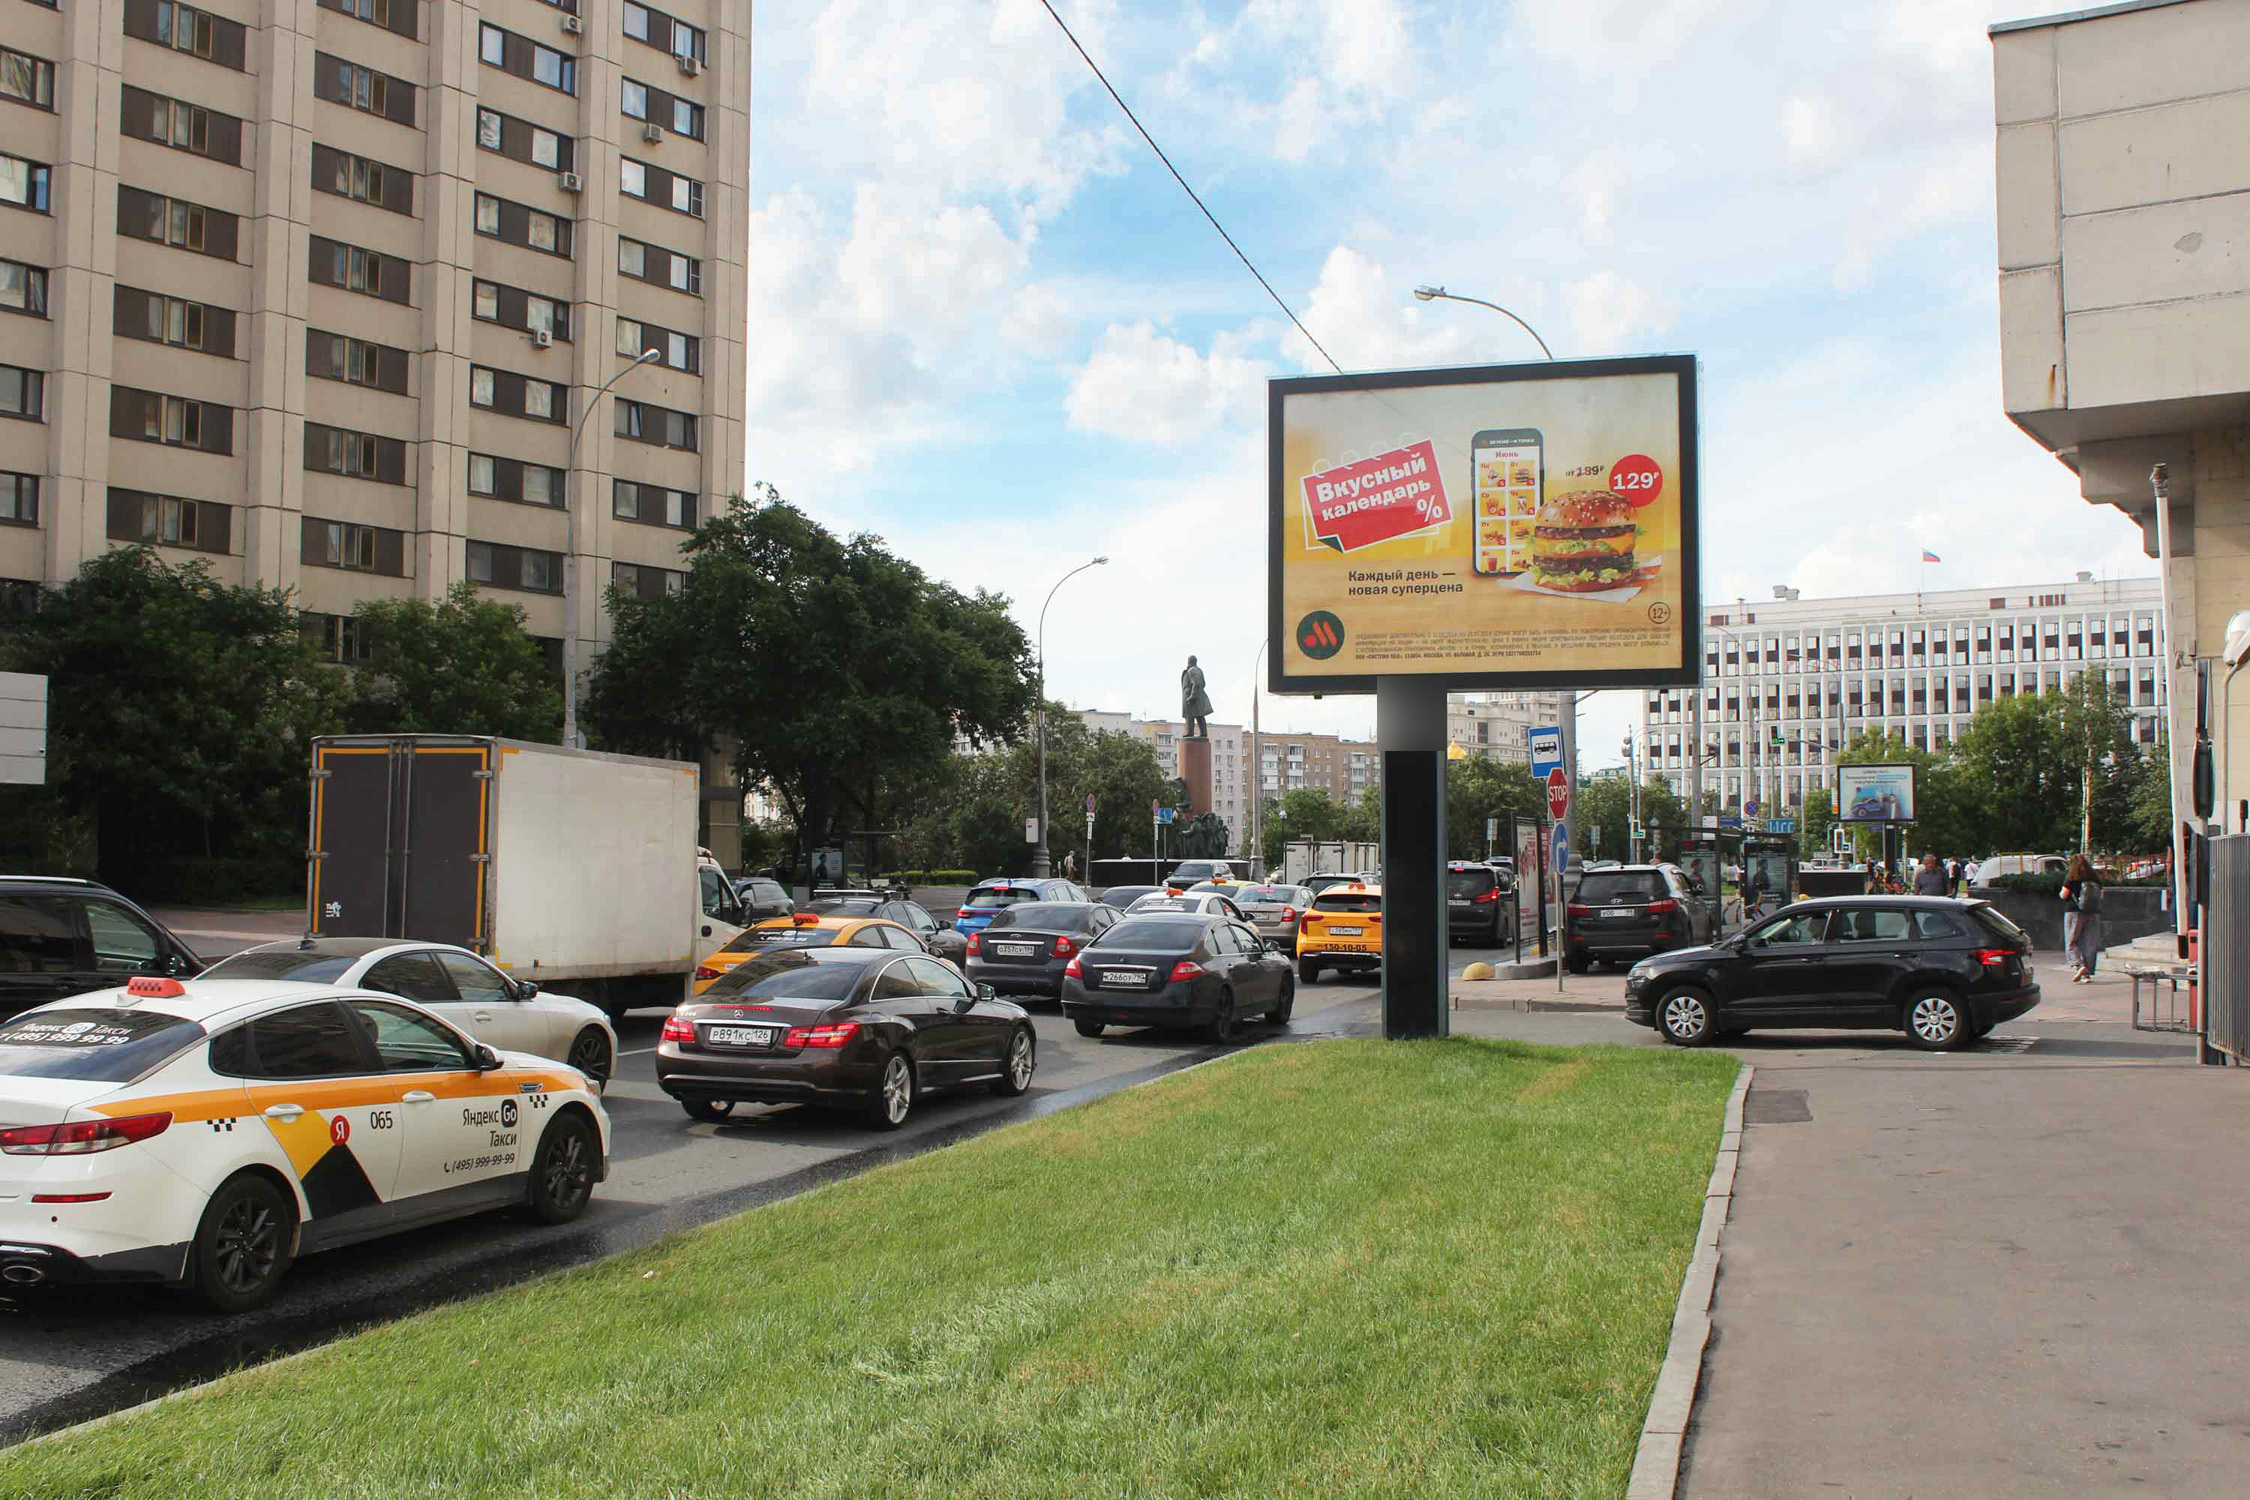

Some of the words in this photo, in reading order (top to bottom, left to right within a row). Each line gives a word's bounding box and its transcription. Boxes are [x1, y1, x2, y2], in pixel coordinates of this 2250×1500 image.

[1316, 452, 1427, 503] Вкусный
[1321, 480, 1431, 521] календарь
[1417, 495, 1443, 523] %
[1348, 570, 1402, 582] Каждый
[1406, 570, 1439, 582] день
[1348, 586, 1388, 596] новая
[1392, 583, 1464, 596] суперцена
[1652, 607, 1669, 619] 12+
[1548, 784, 1567, 802] STOP
[93, 1024, 132, 1034] Такси
[712, 1028, 752, 1041] Р891КС
[754, 1030, 768, 1039] 126
[46, 1033, 82, 1042] 999
[78, 1034, 105, 1043] 99
[102, 1036, 130, 1045] 99
[370, 1111, 393, 1130] 065
[462, 1108, 500, 1127] Яндекс
[336, 1121, 345, 1140] Я
[490, 1130, 517, 1148] Такси
[452, 1158, 474, 1174] (495)
[474, 1153, 516, 1168] 999-99-99
